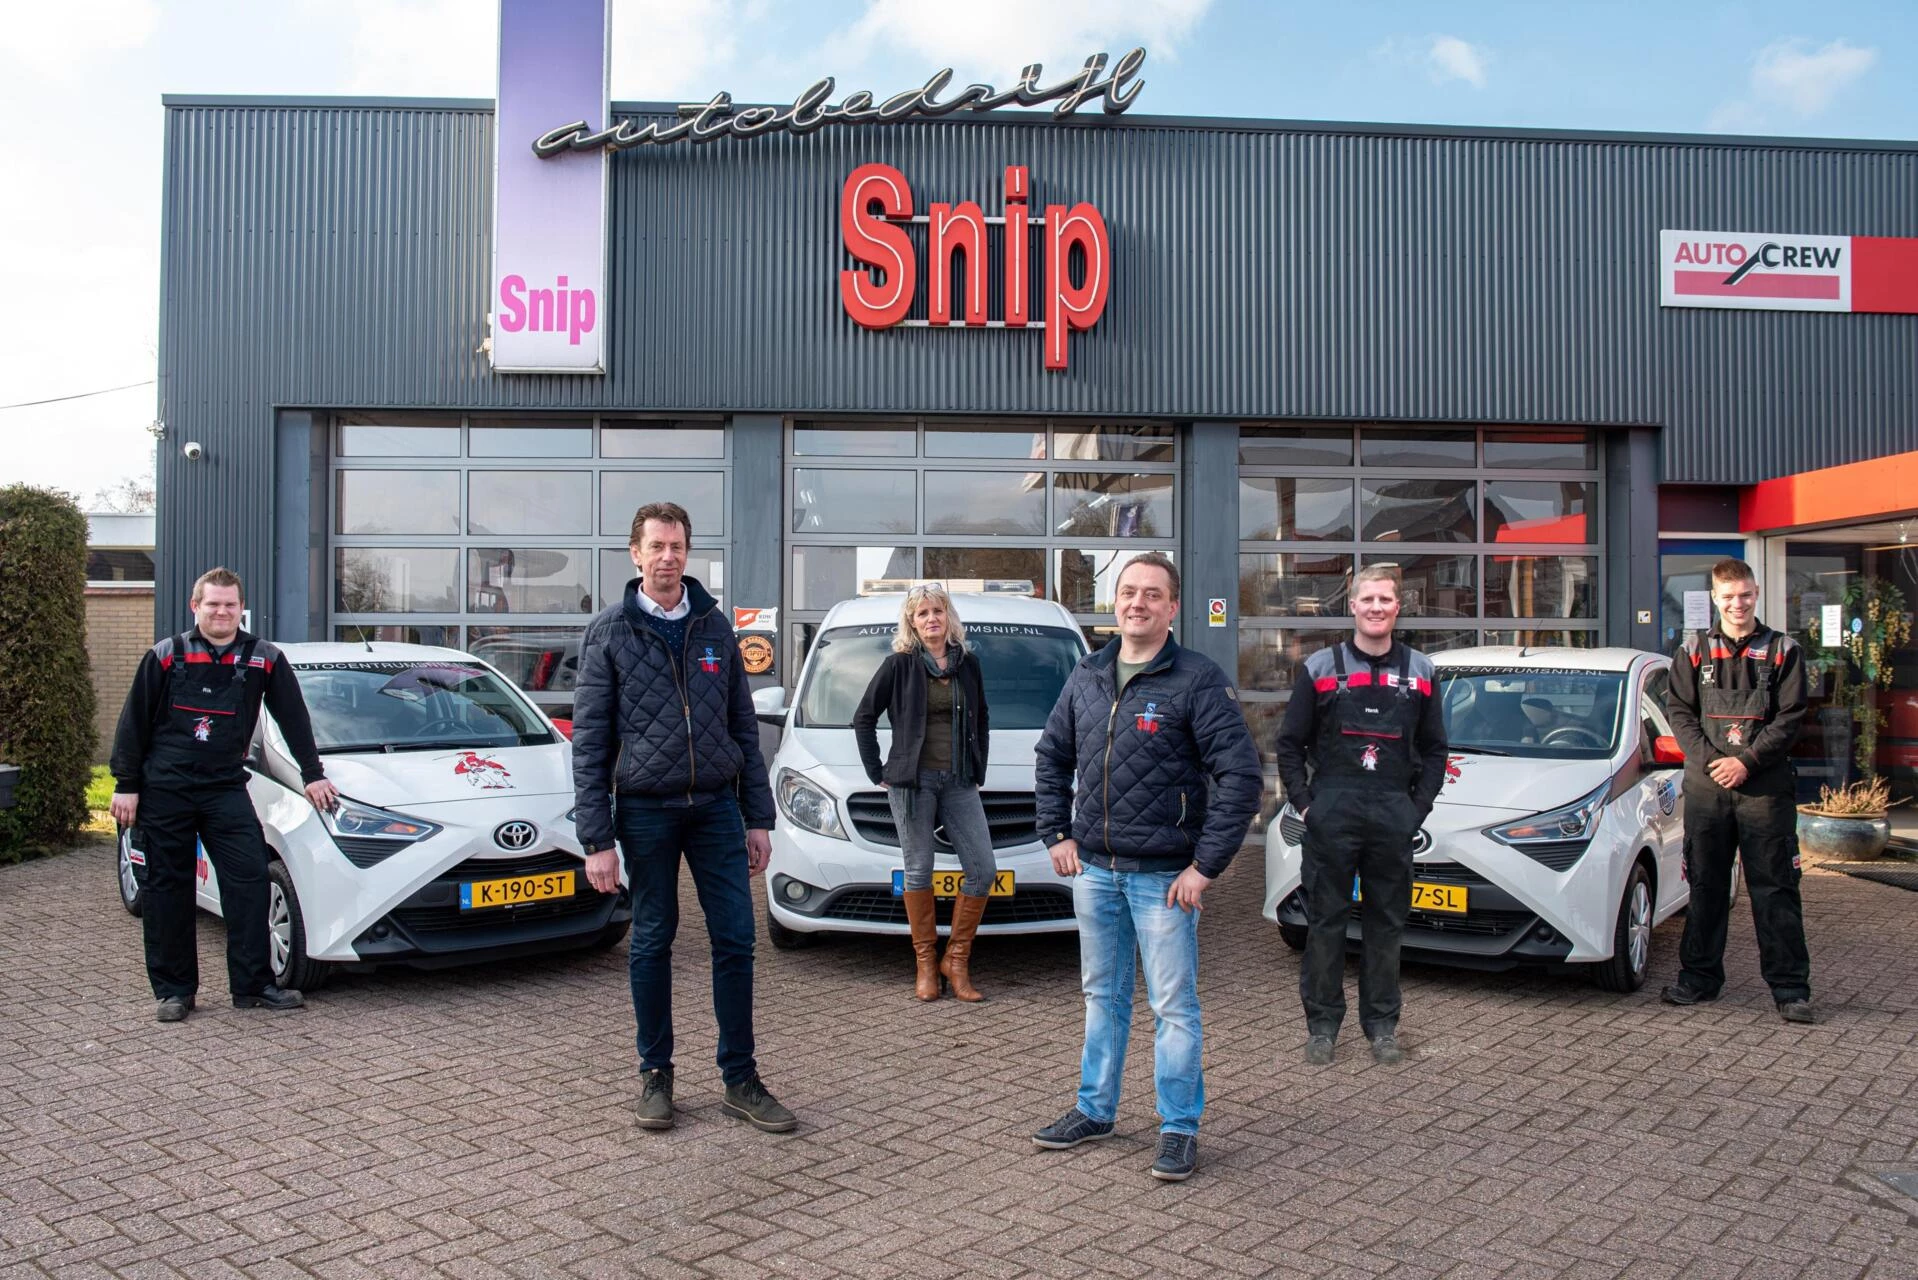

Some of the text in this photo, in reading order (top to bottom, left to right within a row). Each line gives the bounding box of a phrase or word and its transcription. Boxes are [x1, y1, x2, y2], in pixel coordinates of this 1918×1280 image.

[532, 47, 1146, 159] autobedrijf
[840, 163, 1109, 371] Snip
[1674, 242, 1841, 268] AUTO CREW
[500, 274, 596, 345] Snip
[481, 875, 566, 903] K-190-ST
